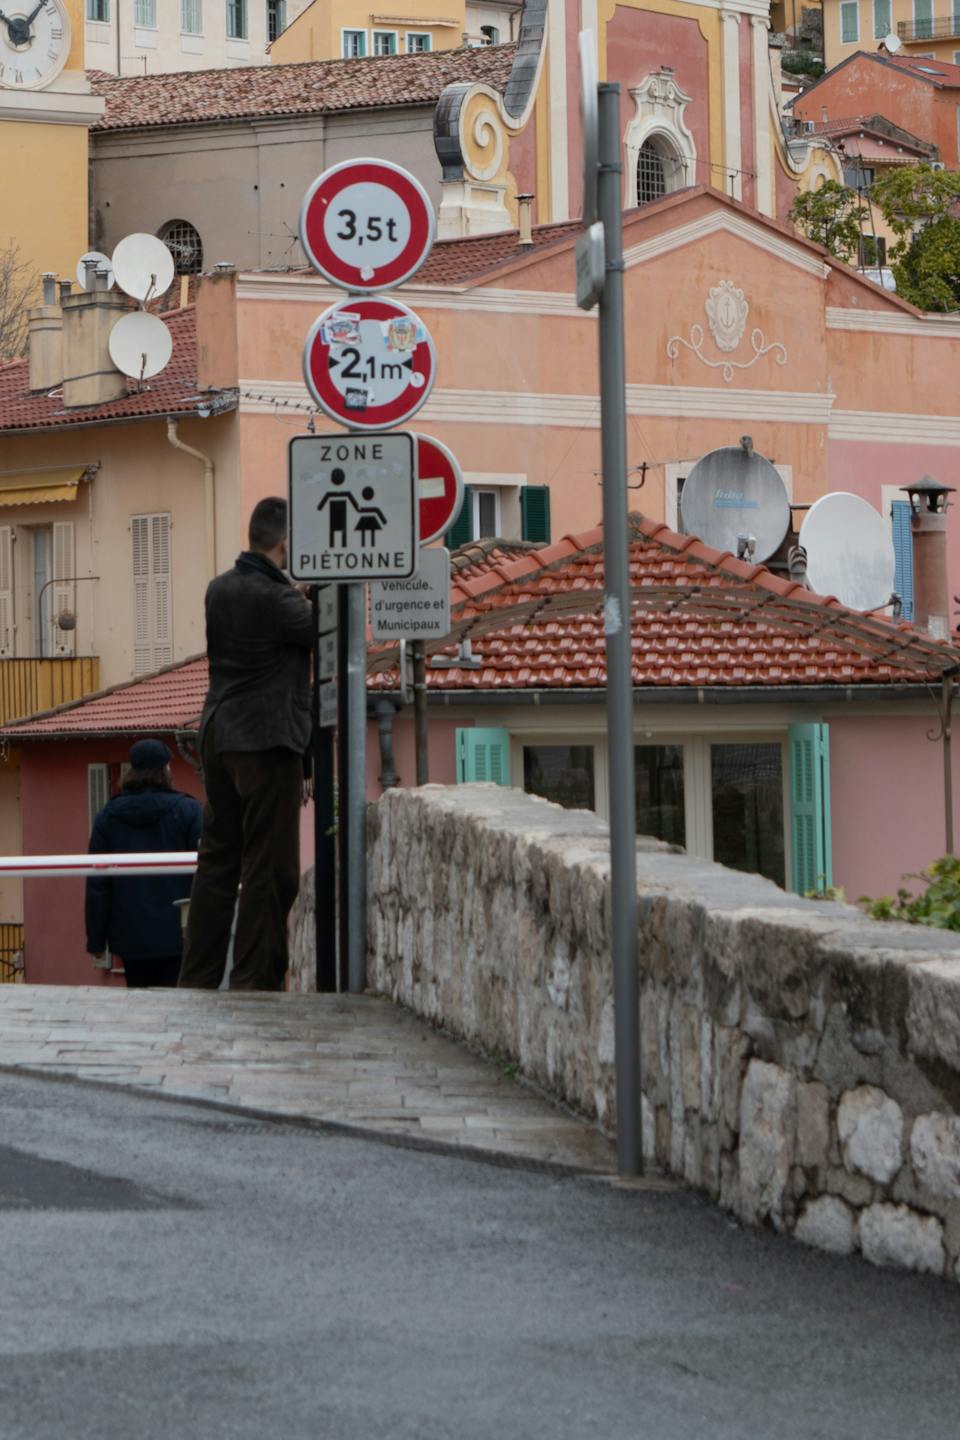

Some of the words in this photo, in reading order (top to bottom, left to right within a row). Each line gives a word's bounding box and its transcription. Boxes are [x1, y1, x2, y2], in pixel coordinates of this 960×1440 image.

[321, 444, 383, 462] ZONE
[300, 549, 405, 571] PIÉTONNE
[374, 599, 431, 613] d'urgence
[433, 598, 445, 609] et
[377, 619, 441, 633] Municipaux
